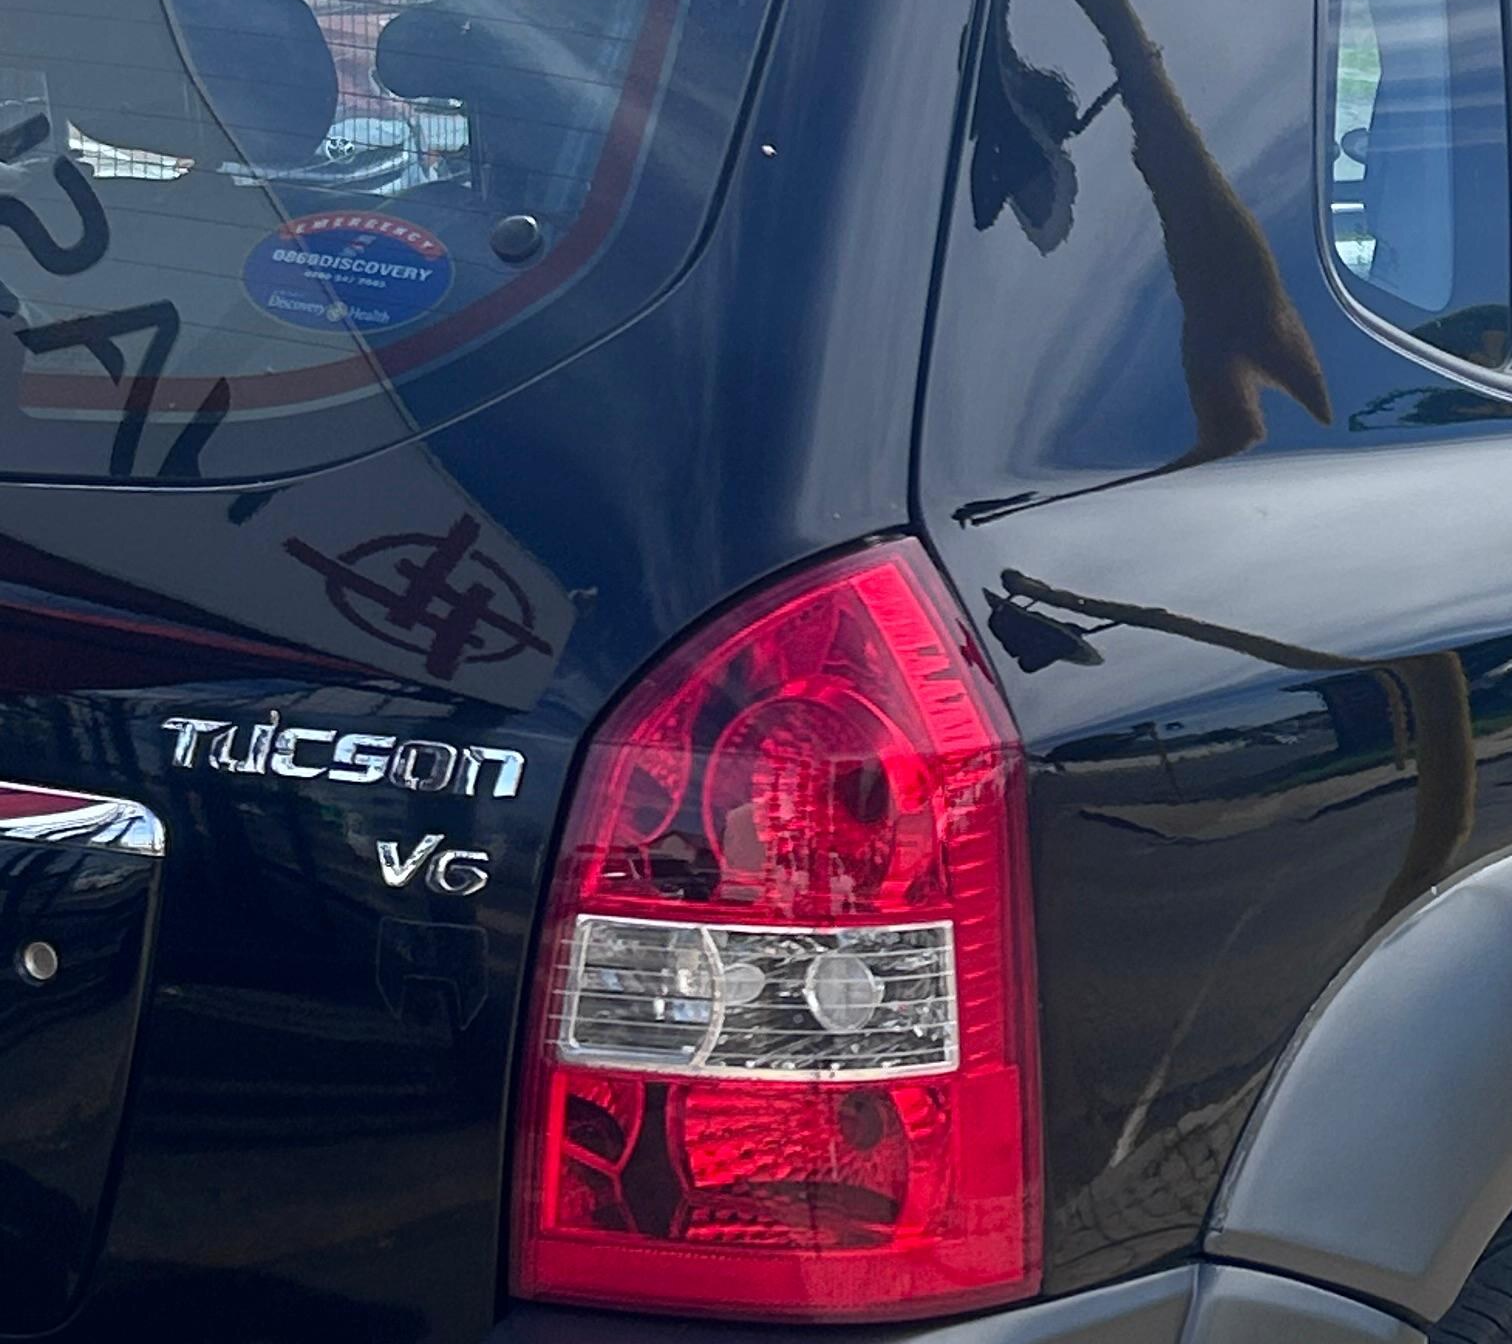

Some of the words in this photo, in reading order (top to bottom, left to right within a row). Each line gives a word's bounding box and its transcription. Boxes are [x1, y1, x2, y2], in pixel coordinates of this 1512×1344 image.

[295, 216, 435, 250] EMERGENCY
[267, 294, 326, 317] Discovery
[349, 307, 390, 325] Health
[375, 833, 489, 896] V6
